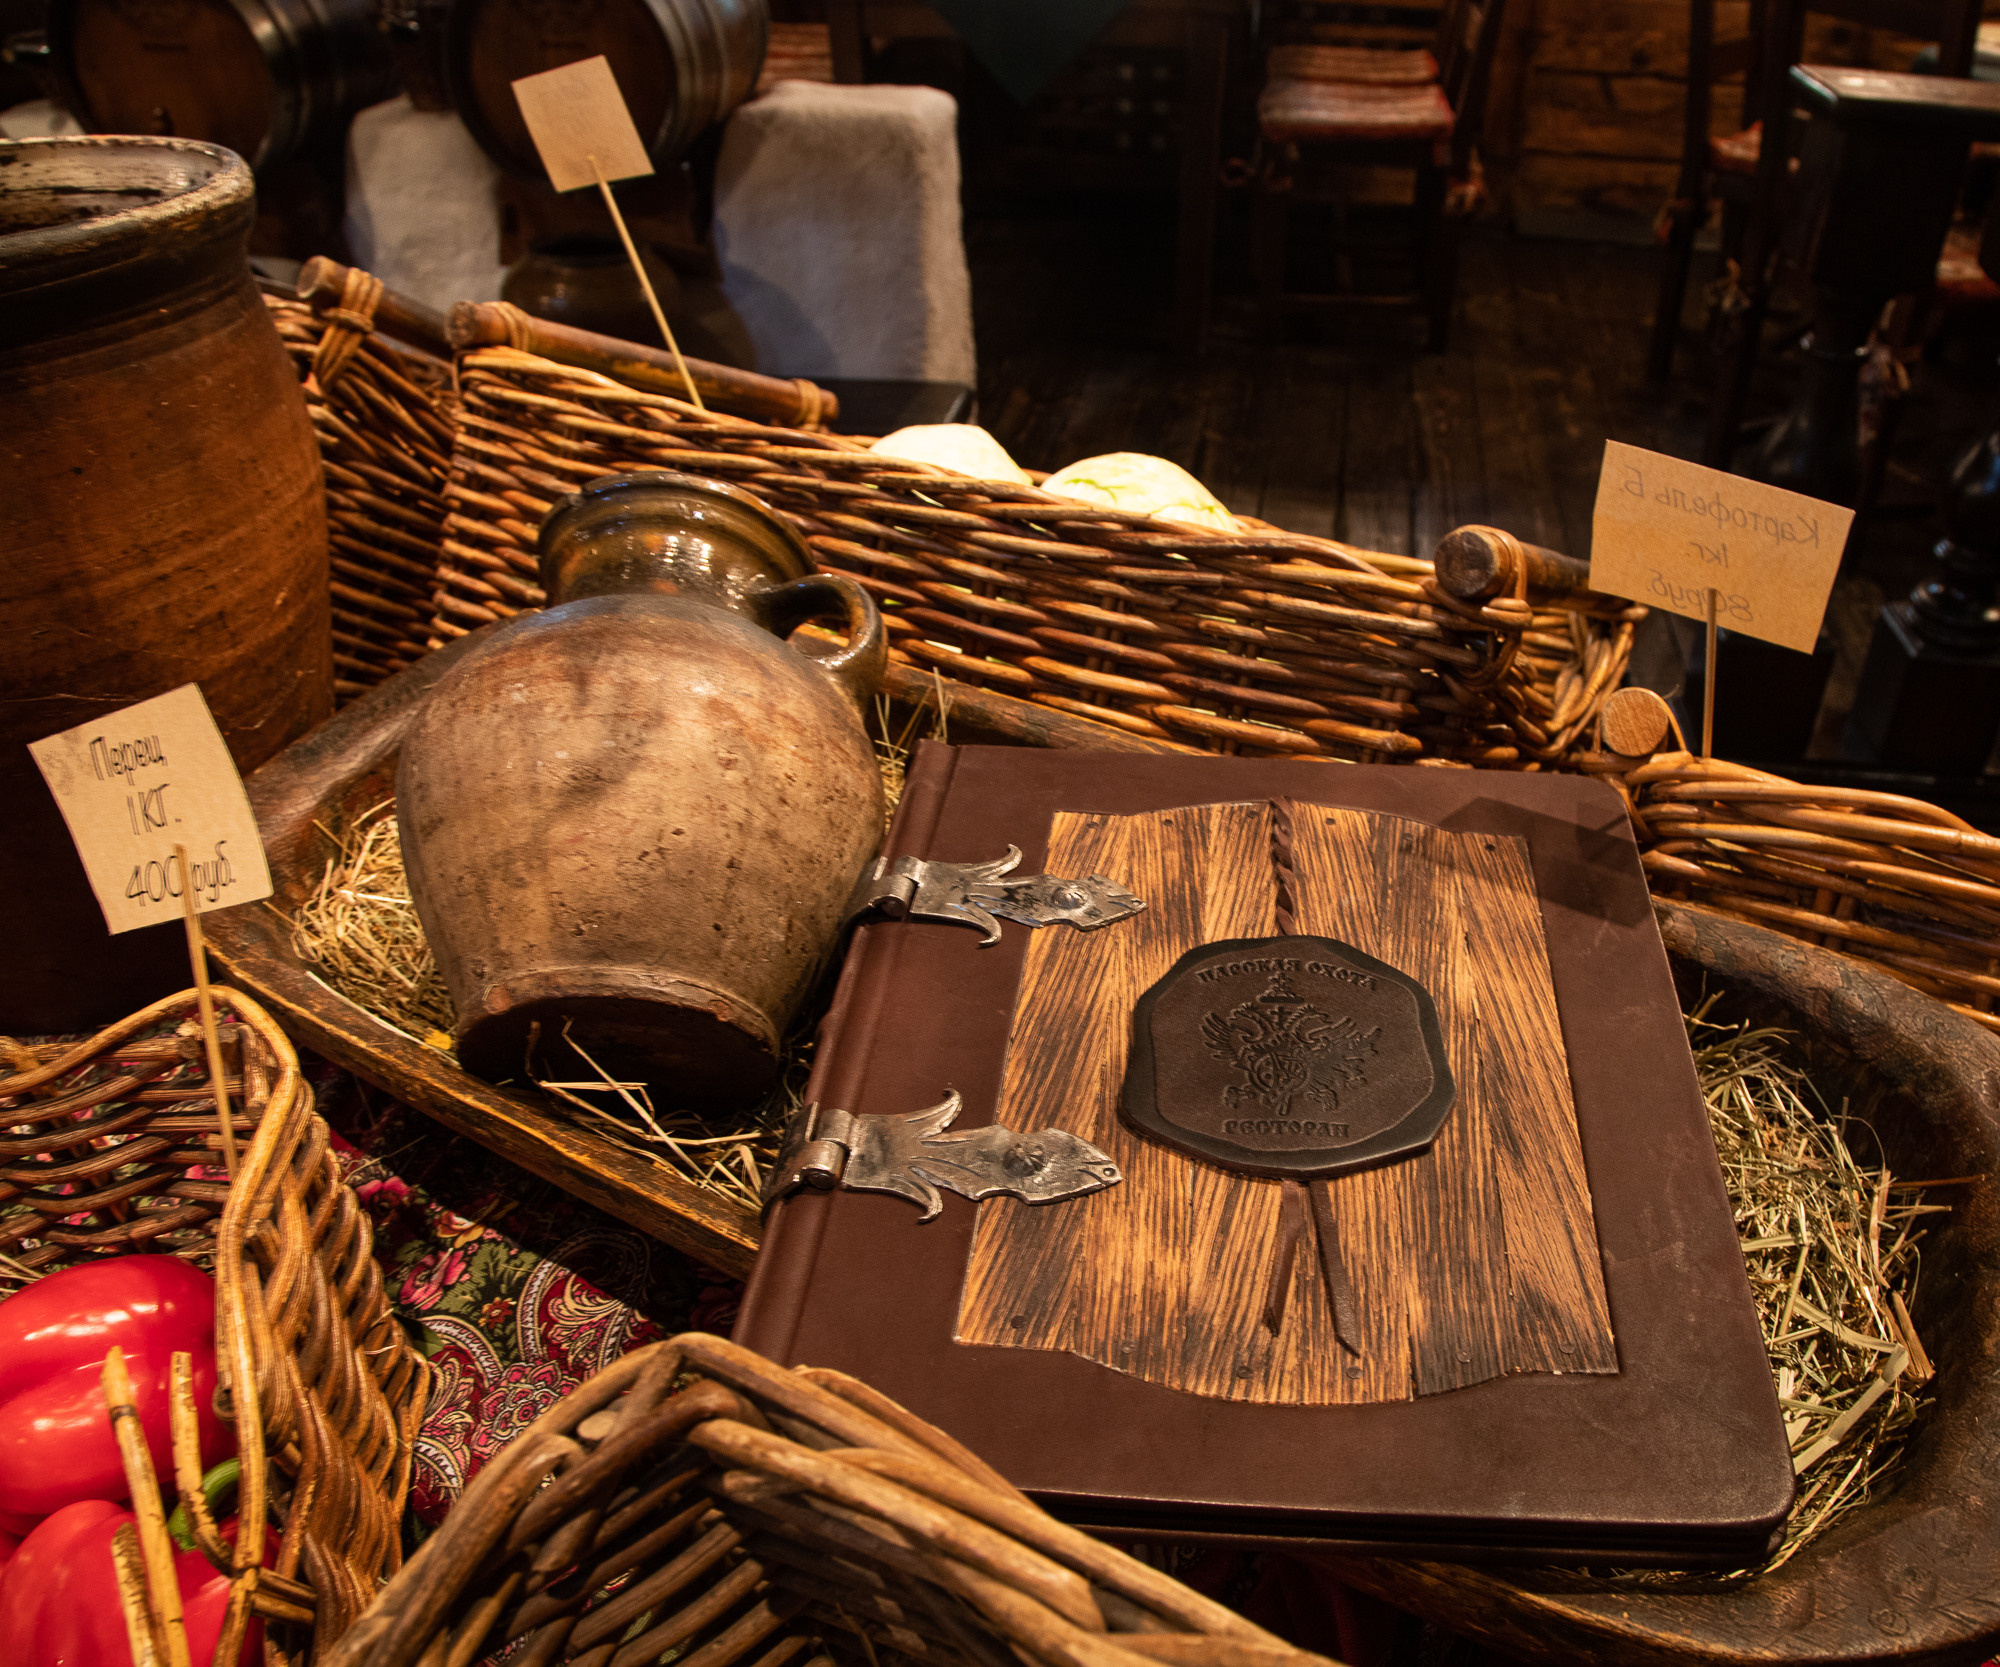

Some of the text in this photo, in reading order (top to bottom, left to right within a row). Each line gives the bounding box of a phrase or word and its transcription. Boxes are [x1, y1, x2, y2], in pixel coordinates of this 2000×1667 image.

[88, 735, 168, 786] Перец
[1304, 960, 1379, 991] ОХОТА
[1222, 1118, 1350, 1138] РЕСТОРАН
